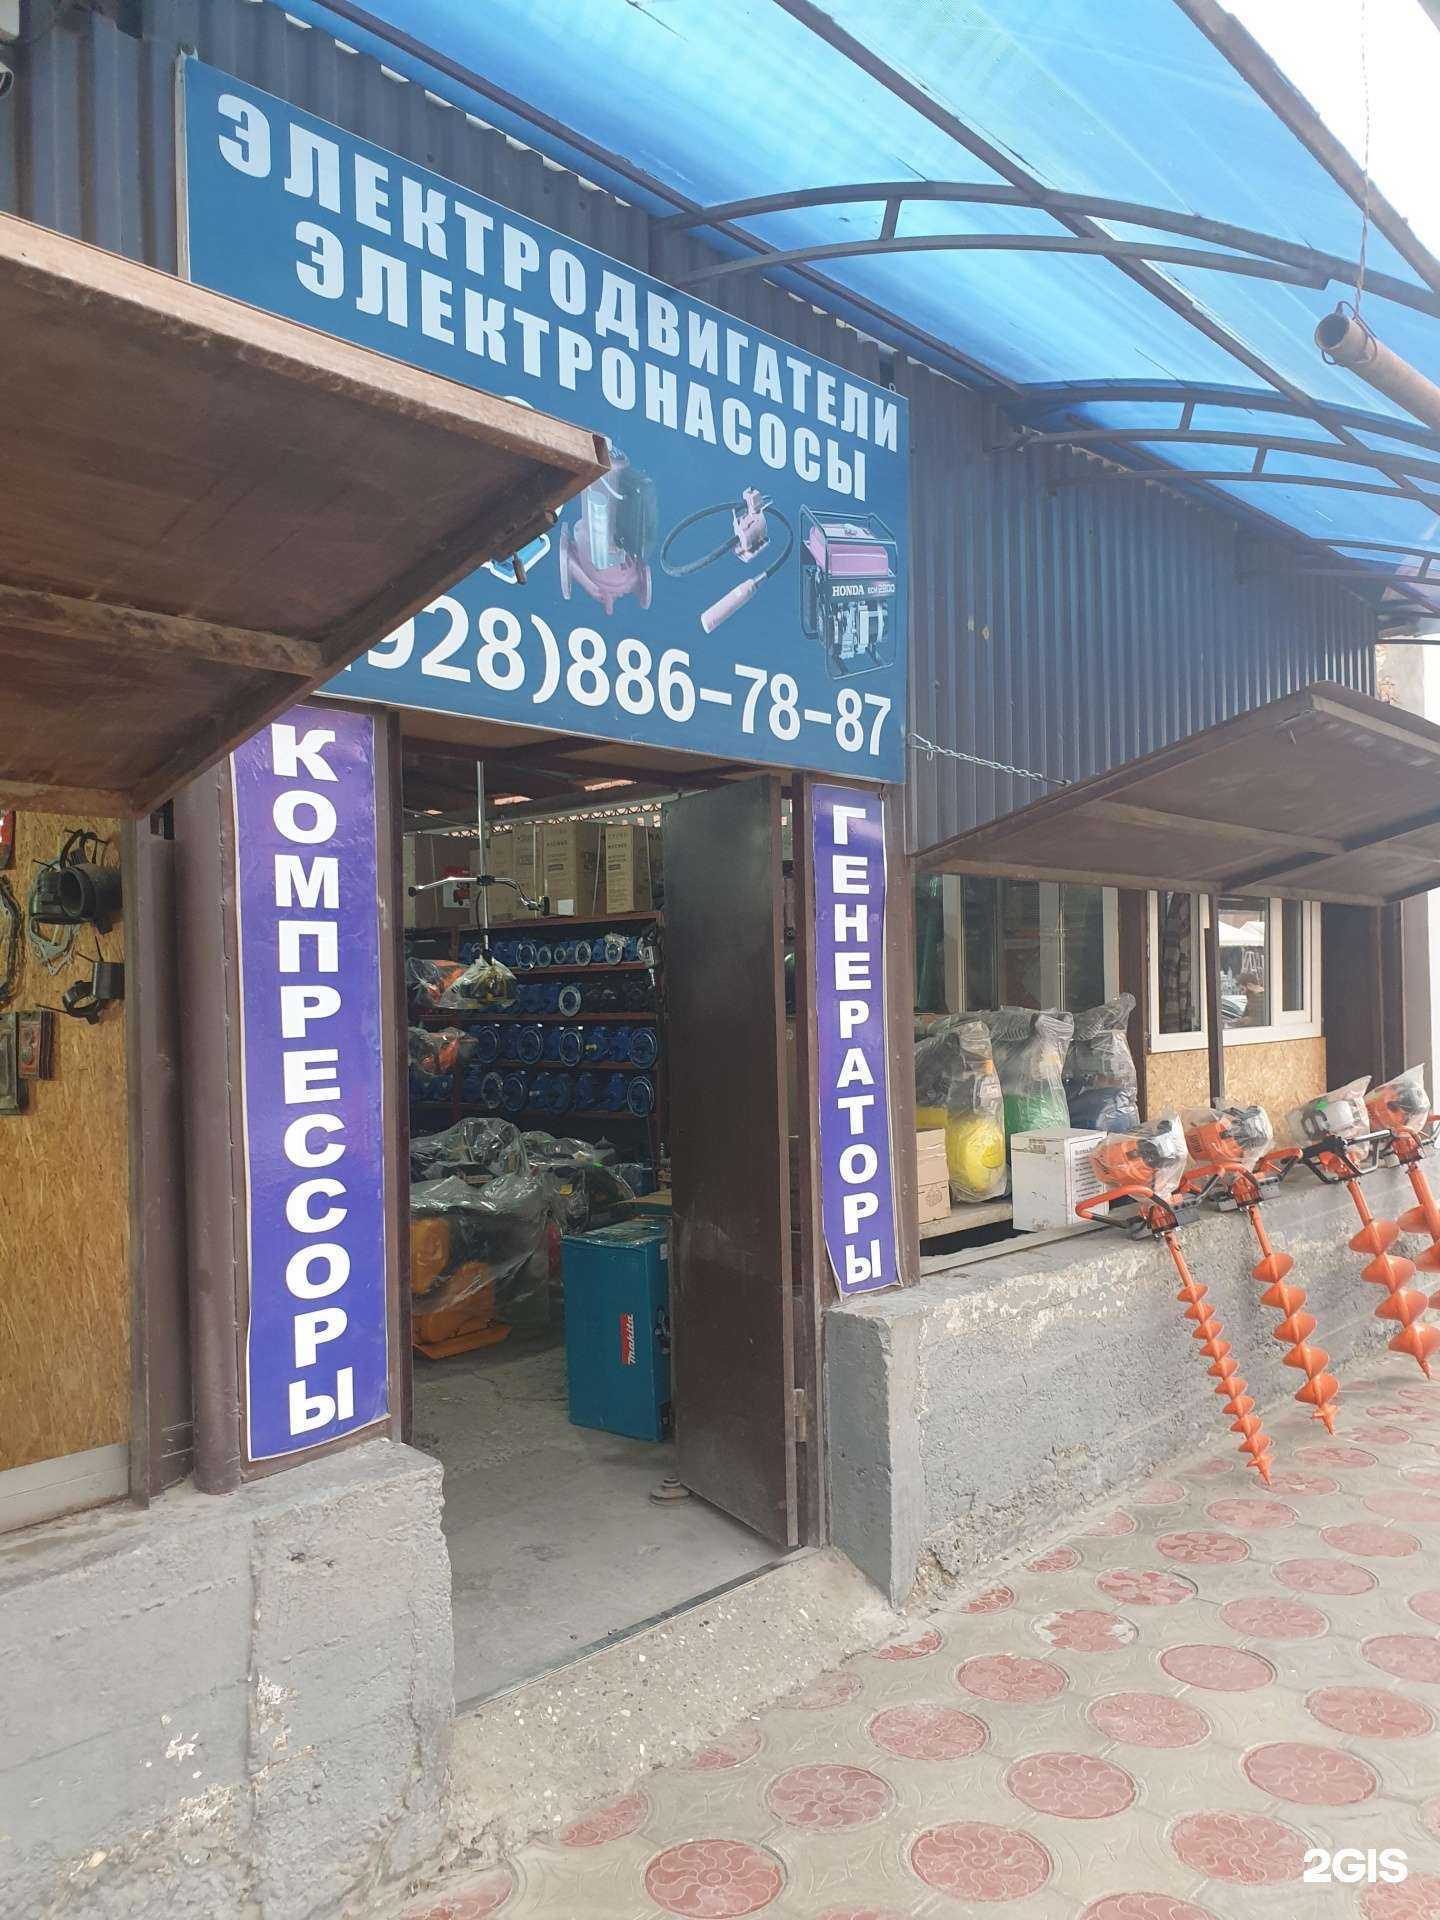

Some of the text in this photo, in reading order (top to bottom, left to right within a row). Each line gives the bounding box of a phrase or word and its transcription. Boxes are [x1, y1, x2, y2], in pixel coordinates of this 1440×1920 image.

[217, 94, 898, 453] ЭЛЕКТРОДВИГАТЕЛИ
[295, 221, 867, 501] ЭЛЕКТРОНАСОСЫ
[832, 585, 865, 597] HONDA
[271, 723, 355, 1436] КОМПРЕССОРЫ
[832, 804, 882, 1286] ГЕНЕРАТОРЫ
